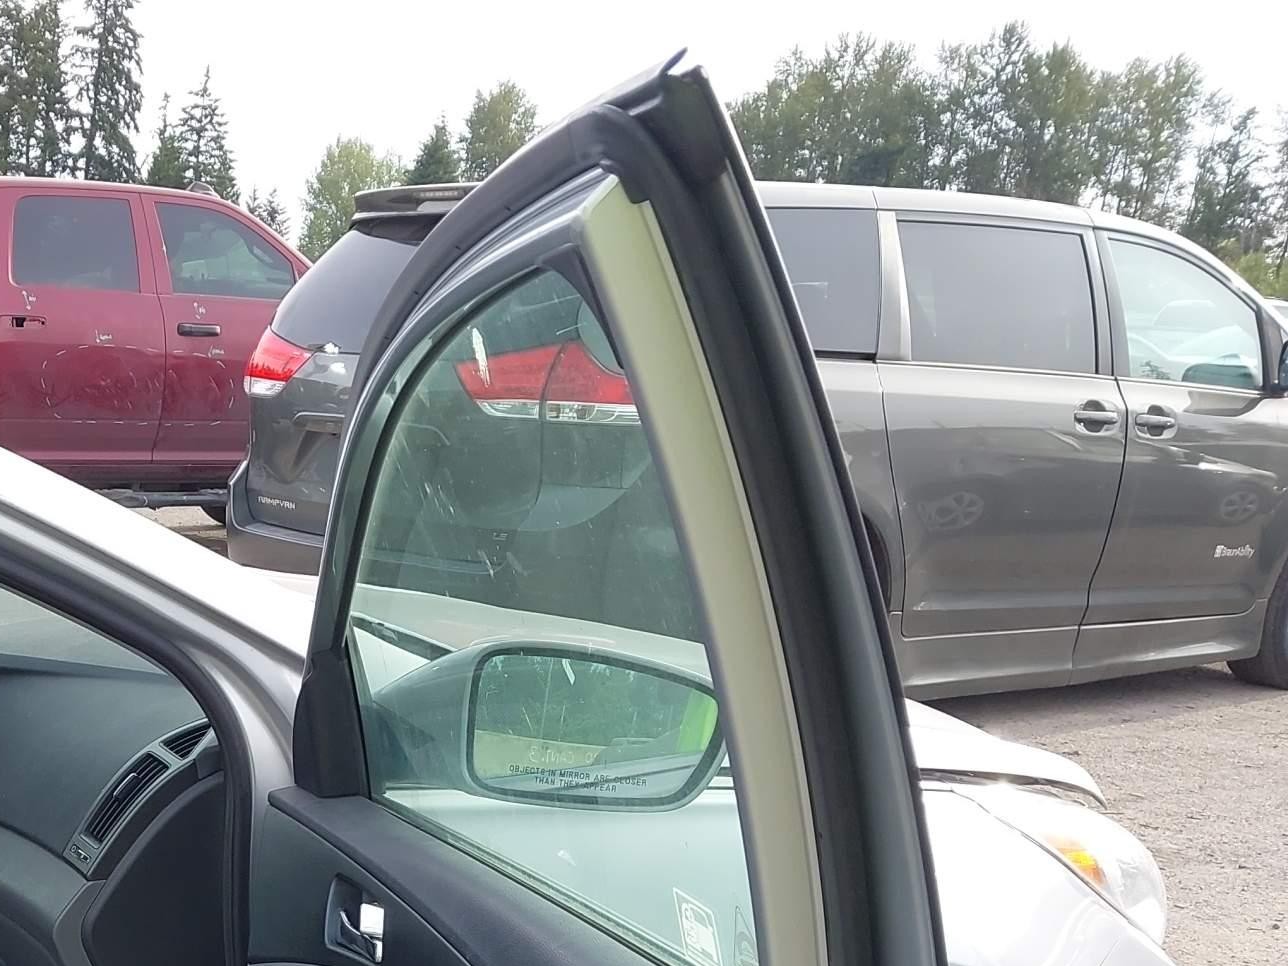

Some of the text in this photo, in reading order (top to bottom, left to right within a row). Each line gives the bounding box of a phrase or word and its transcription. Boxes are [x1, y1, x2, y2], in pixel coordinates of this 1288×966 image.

[509, 764, 545, 775] OBJECTS
[559, 769, 590, 781] MIRROR
[593, 774, 612, 783] ARE
[614, 776, 647, 787] CLOSER
[535, 776, 617, 793] THAN THEY APPEAR
